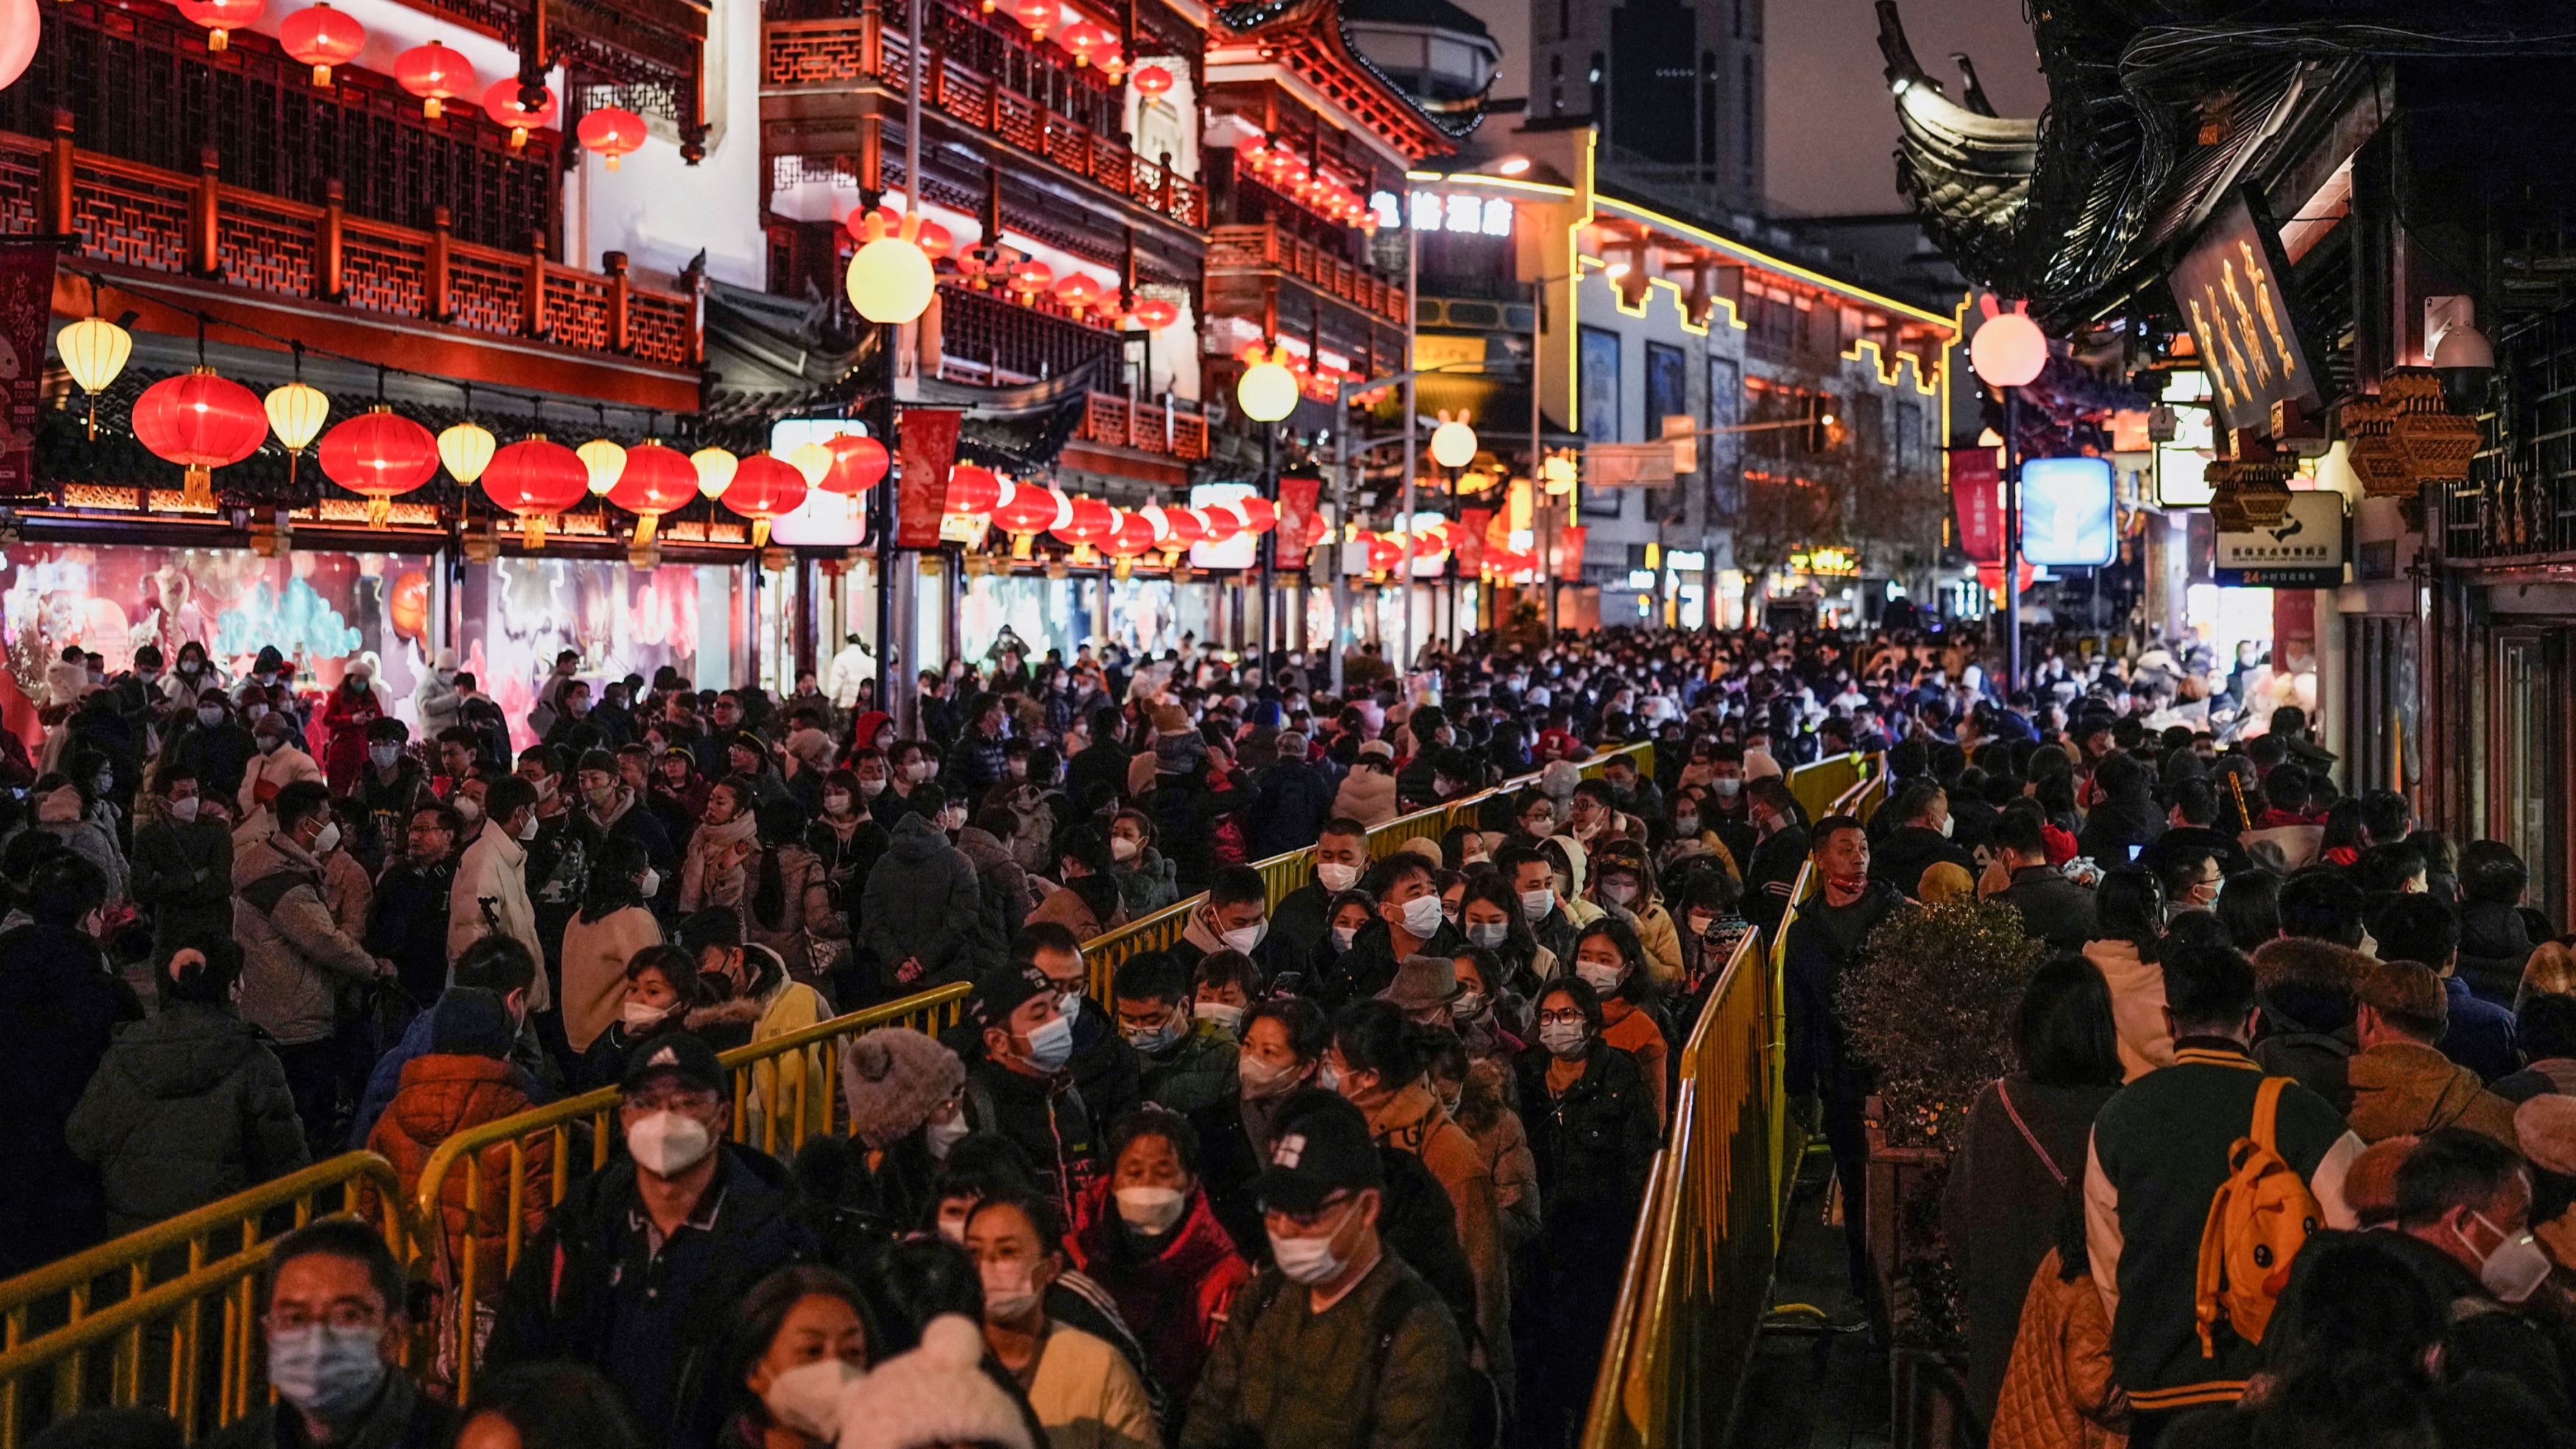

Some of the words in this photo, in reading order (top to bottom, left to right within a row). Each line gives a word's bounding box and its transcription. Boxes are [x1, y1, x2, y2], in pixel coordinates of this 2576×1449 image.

[2232, 547, 2327, 556] 医保定点零售药店
